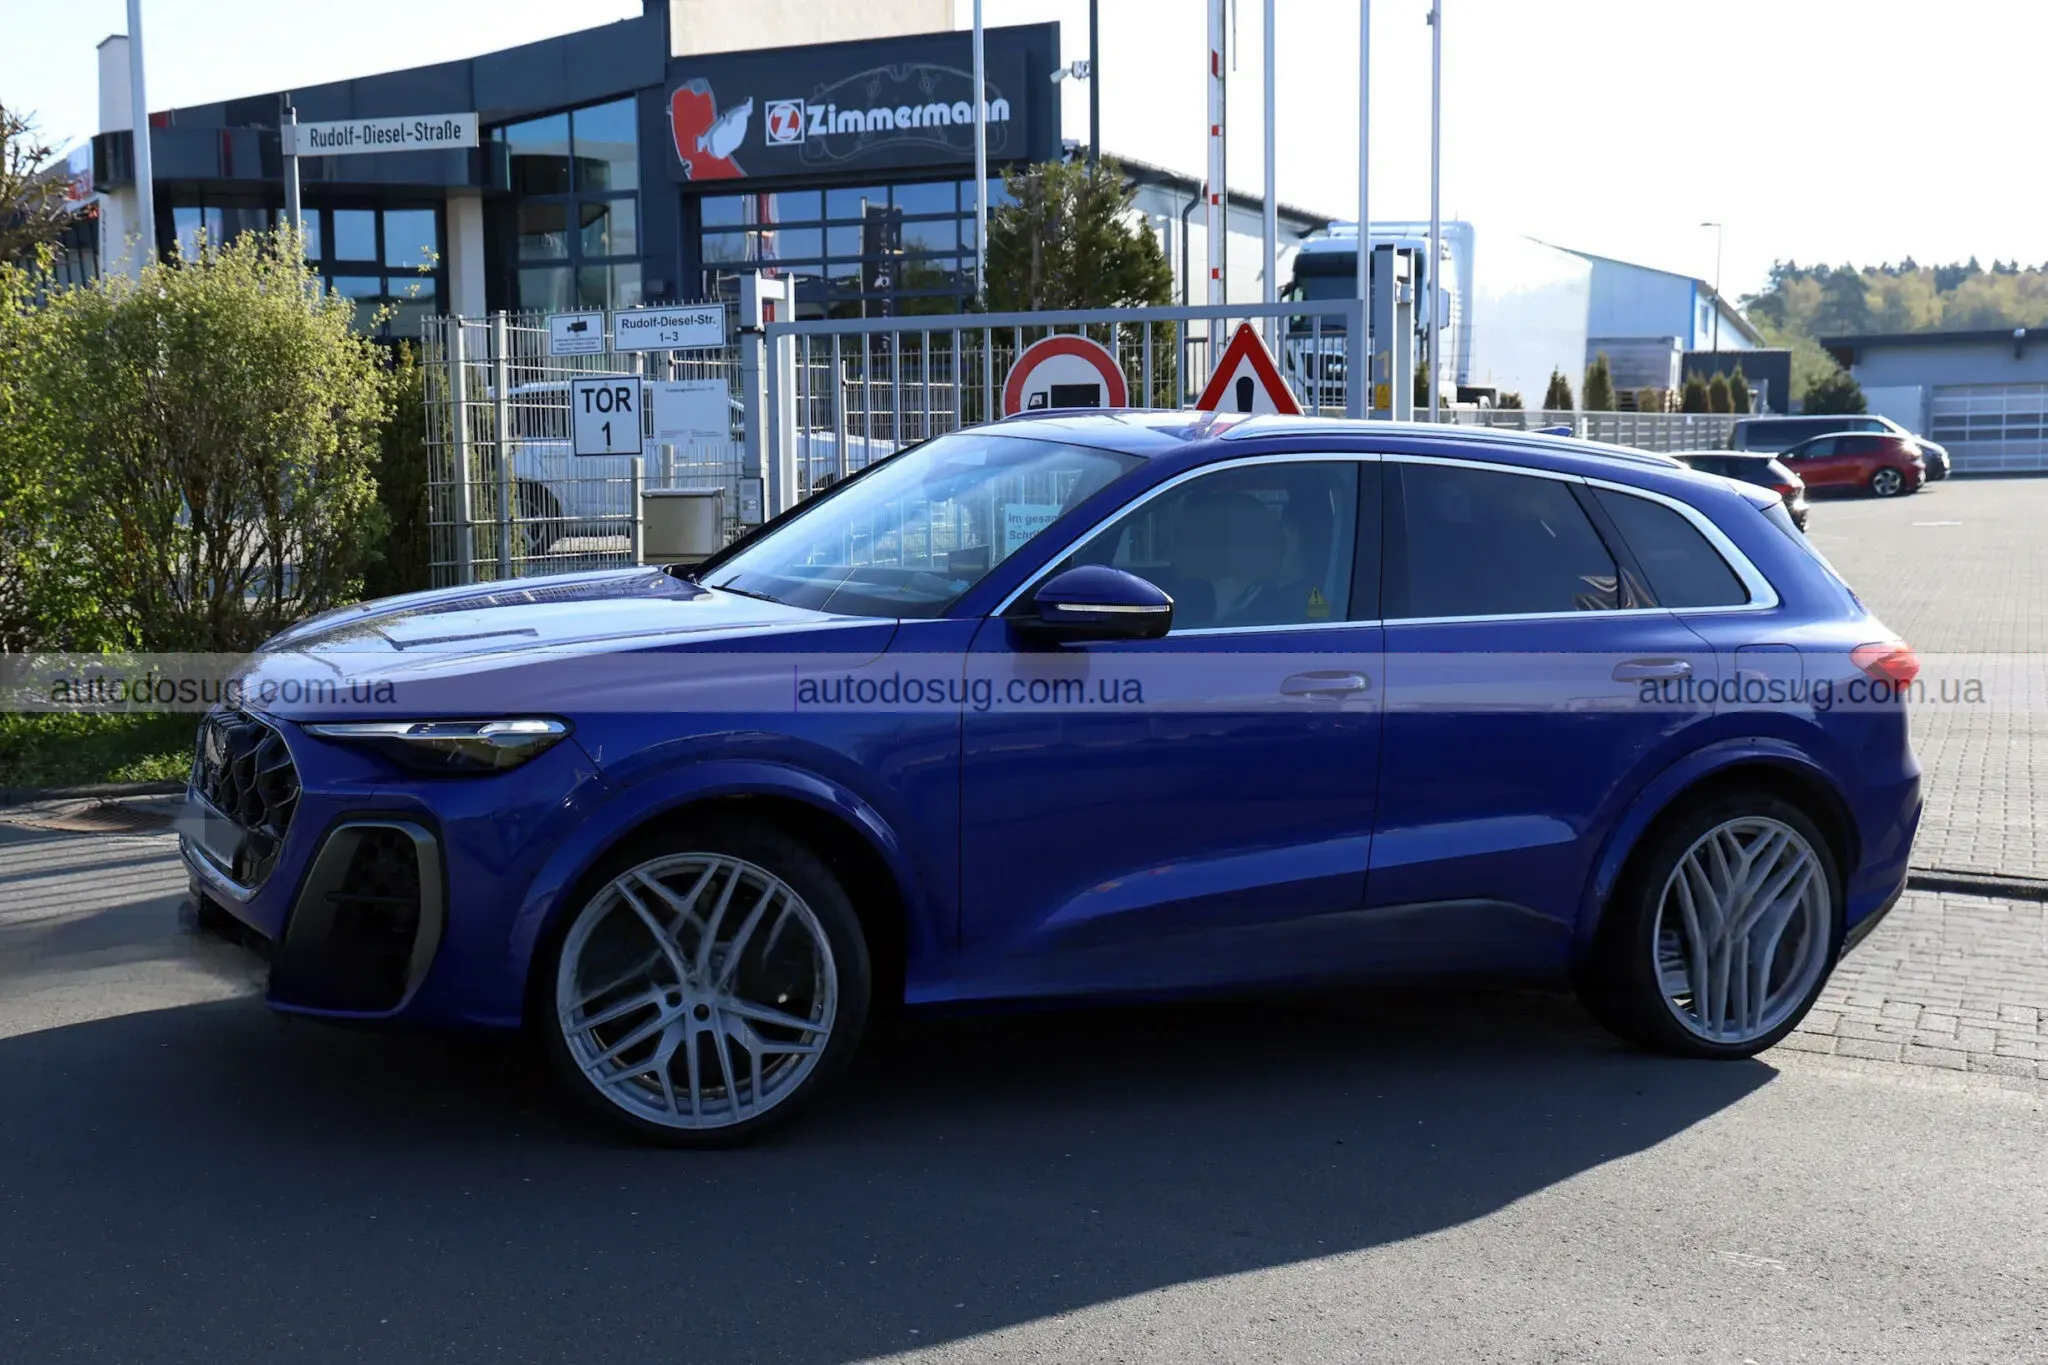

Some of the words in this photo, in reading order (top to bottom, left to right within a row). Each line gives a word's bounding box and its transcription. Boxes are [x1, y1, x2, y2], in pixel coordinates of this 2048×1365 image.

[310, 120, 461, 148] Rudolf-Diesel-Straße
[621, 314, 716, 329] Rudolf-Diesel-Str.
[580, 387, 633, 414] TOR
[601, 421, 611, 447] 1
